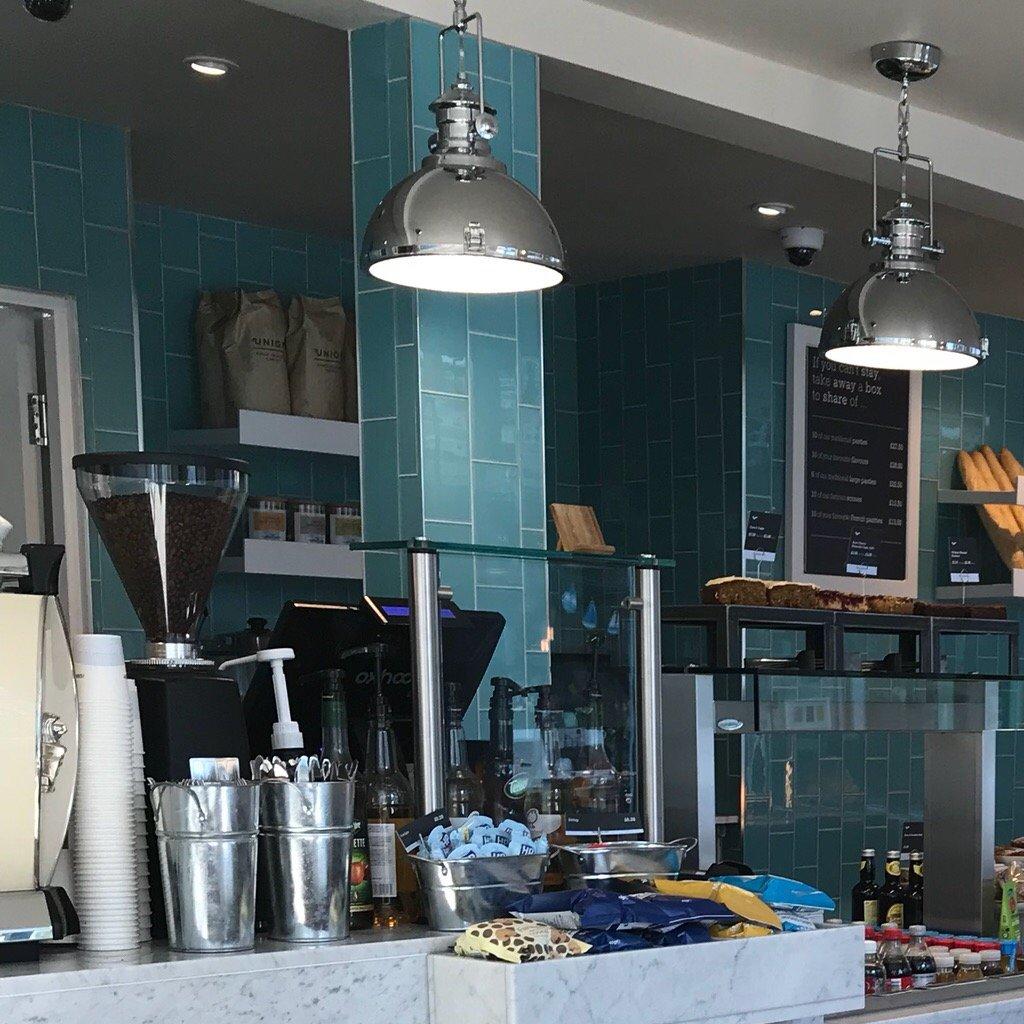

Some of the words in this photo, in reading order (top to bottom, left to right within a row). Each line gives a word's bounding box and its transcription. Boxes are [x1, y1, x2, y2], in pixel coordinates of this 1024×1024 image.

[833, 380, 856, 393] away
[865, 381, 882, 396] box
[822, 391, 848, 406] share
